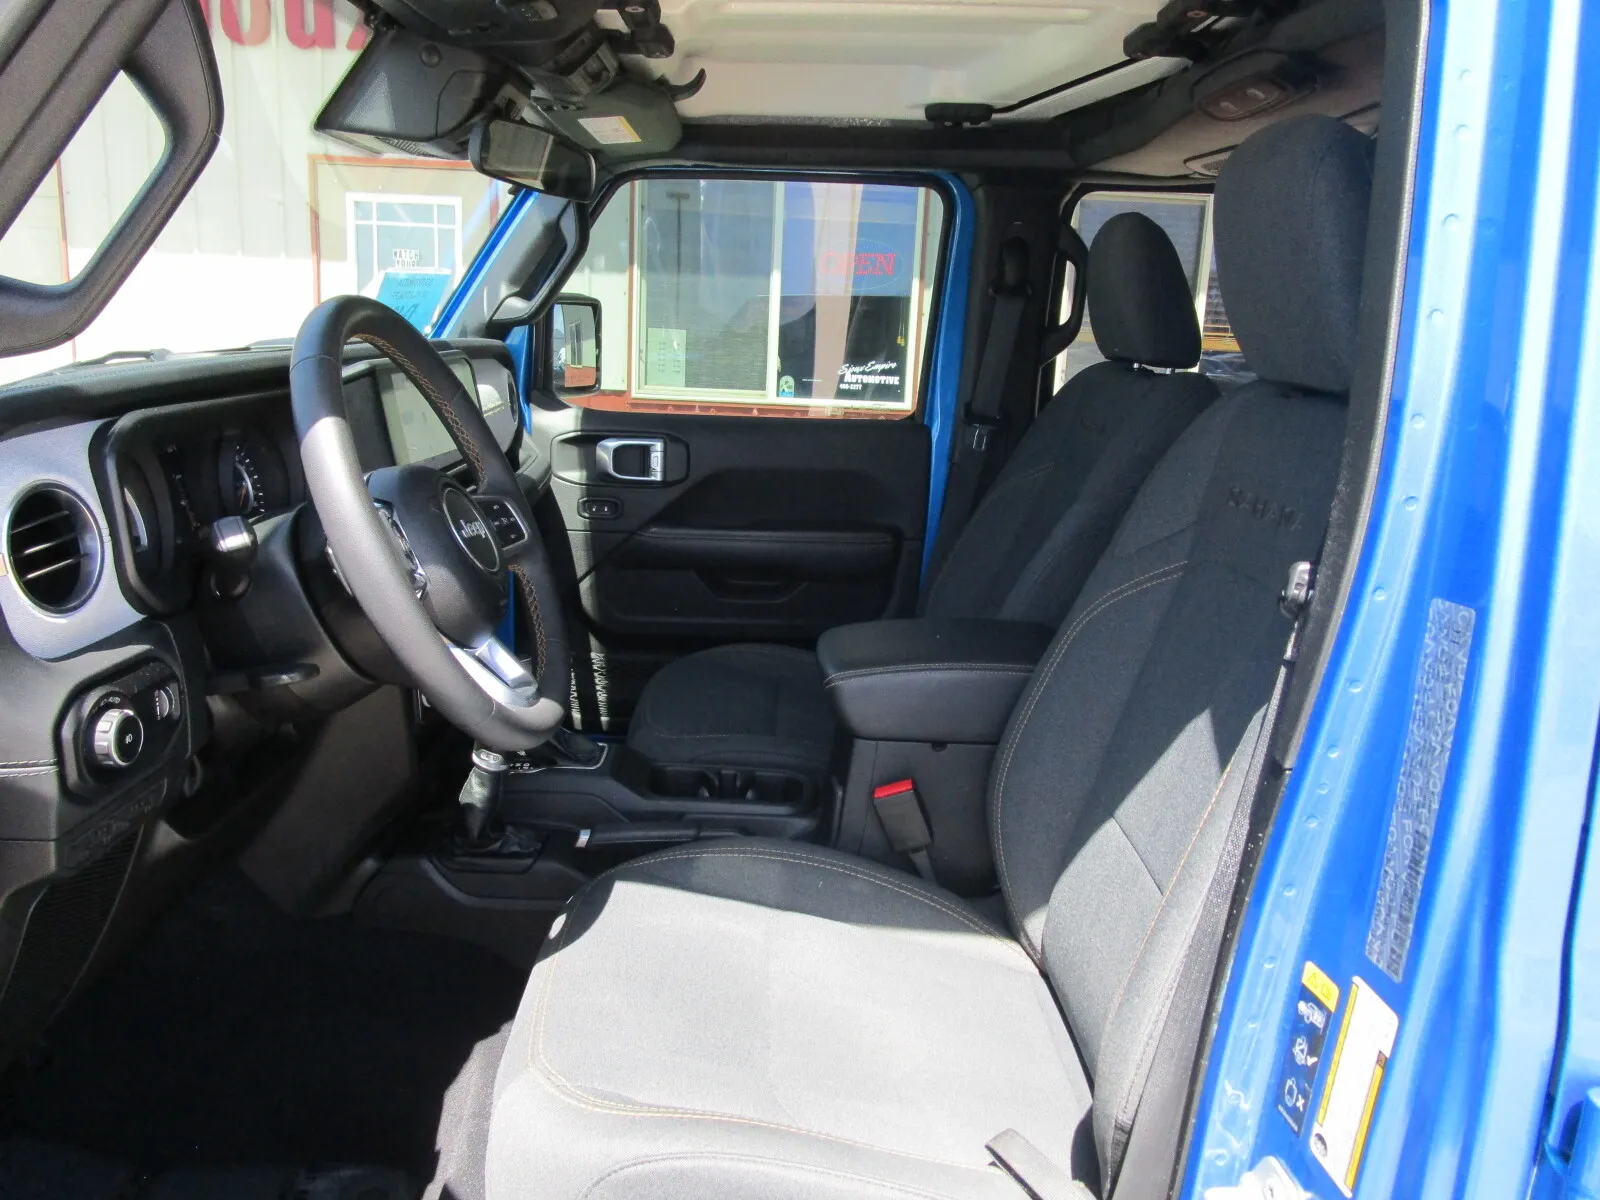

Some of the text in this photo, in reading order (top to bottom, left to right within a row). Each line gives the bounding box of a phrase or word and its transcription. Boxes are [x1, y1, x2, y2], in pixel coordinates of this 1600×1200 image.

[820, 252, 897, 275] OPEN
[838, 360, 898, 375] Sioux Empire
[843, 371, 900, 385] AUTOMOTIVE
[460, 519, 485, 538] Jeep
